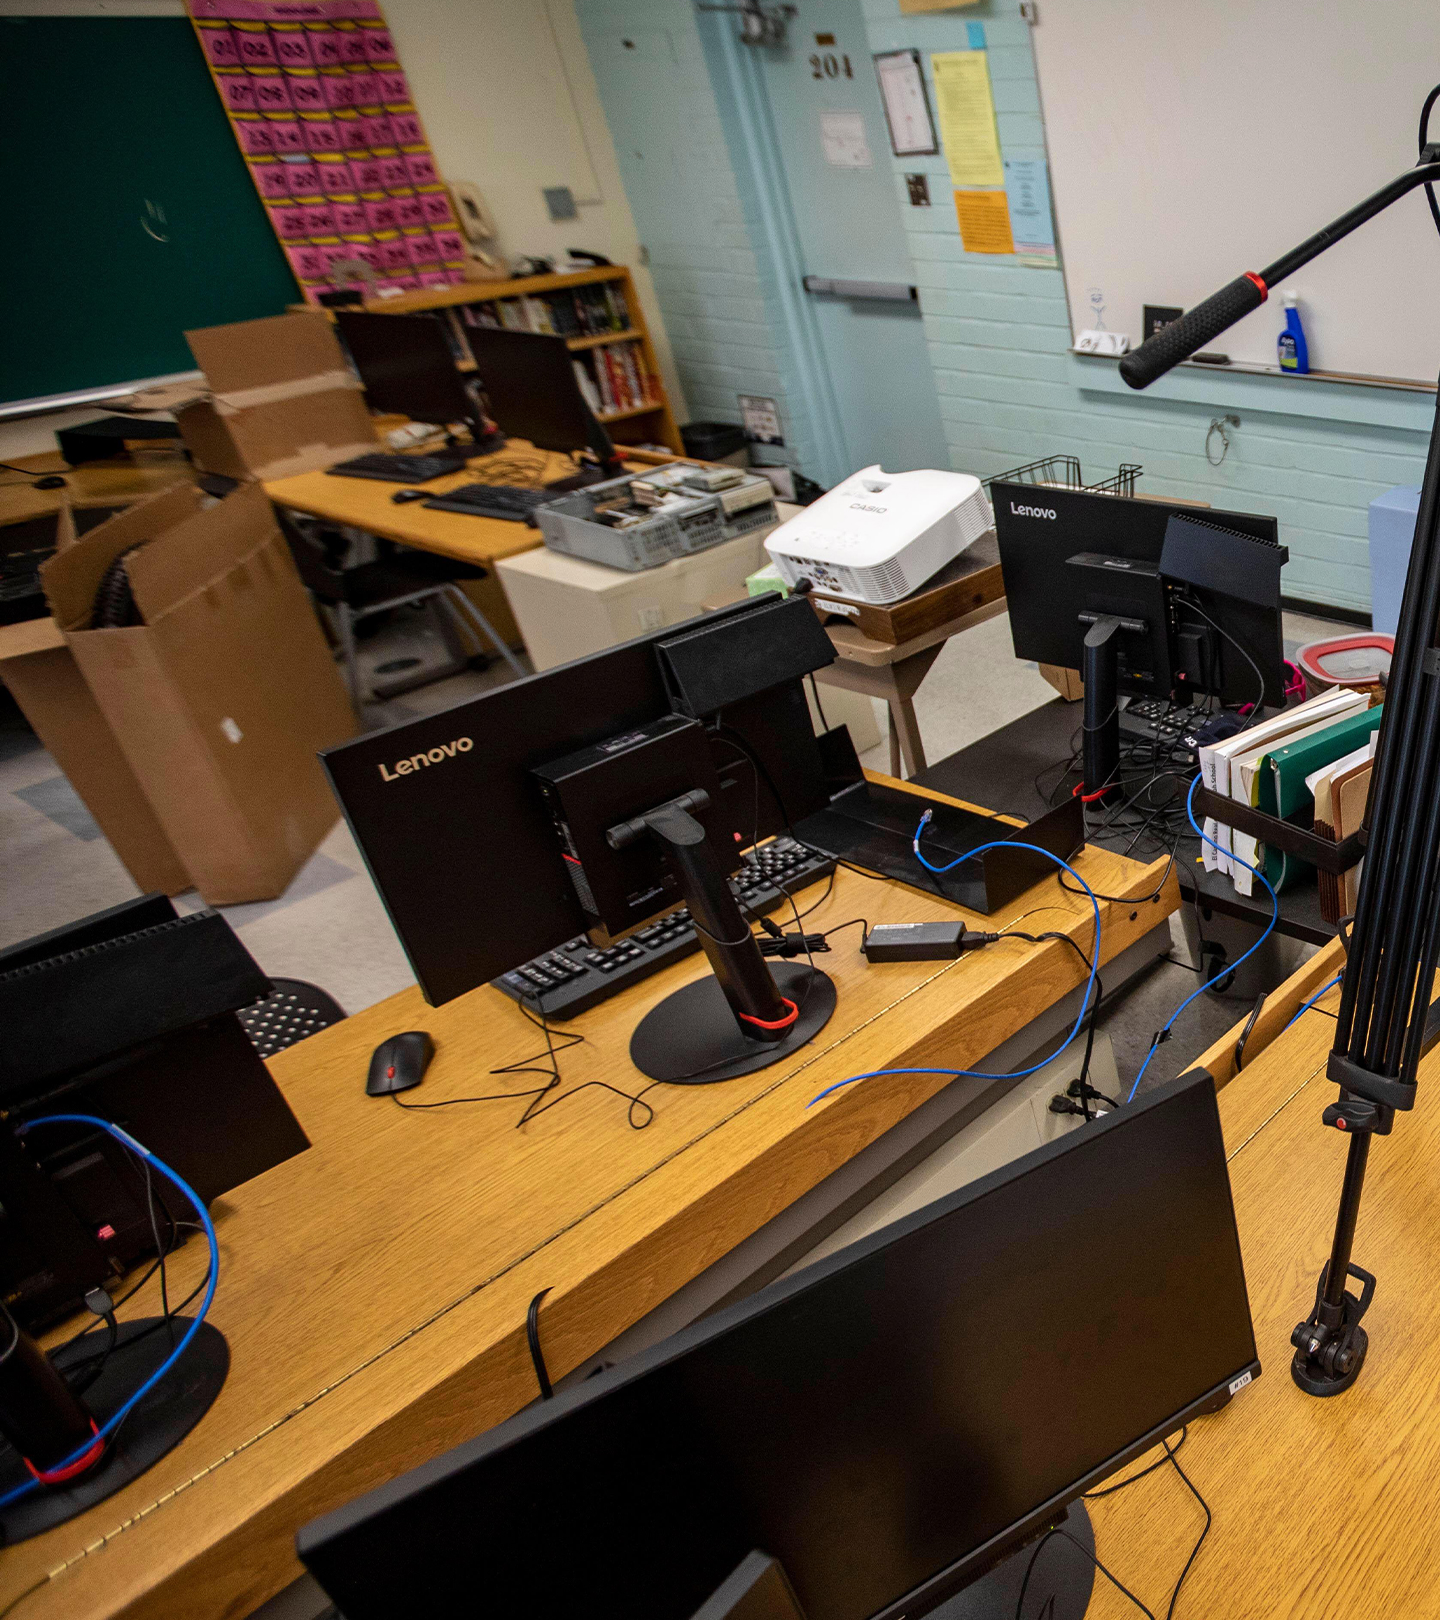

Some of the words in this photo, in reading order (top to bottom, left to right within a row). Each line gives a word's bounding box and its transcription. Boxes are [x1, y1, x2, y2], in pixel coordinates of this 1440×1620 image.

[809, 54, 853, 80] 201
[849, 503, 887, 514] CASIO
[1010, 501, 1057, 520] Lenovo
[378, 737, 474, 782] Lenovo
